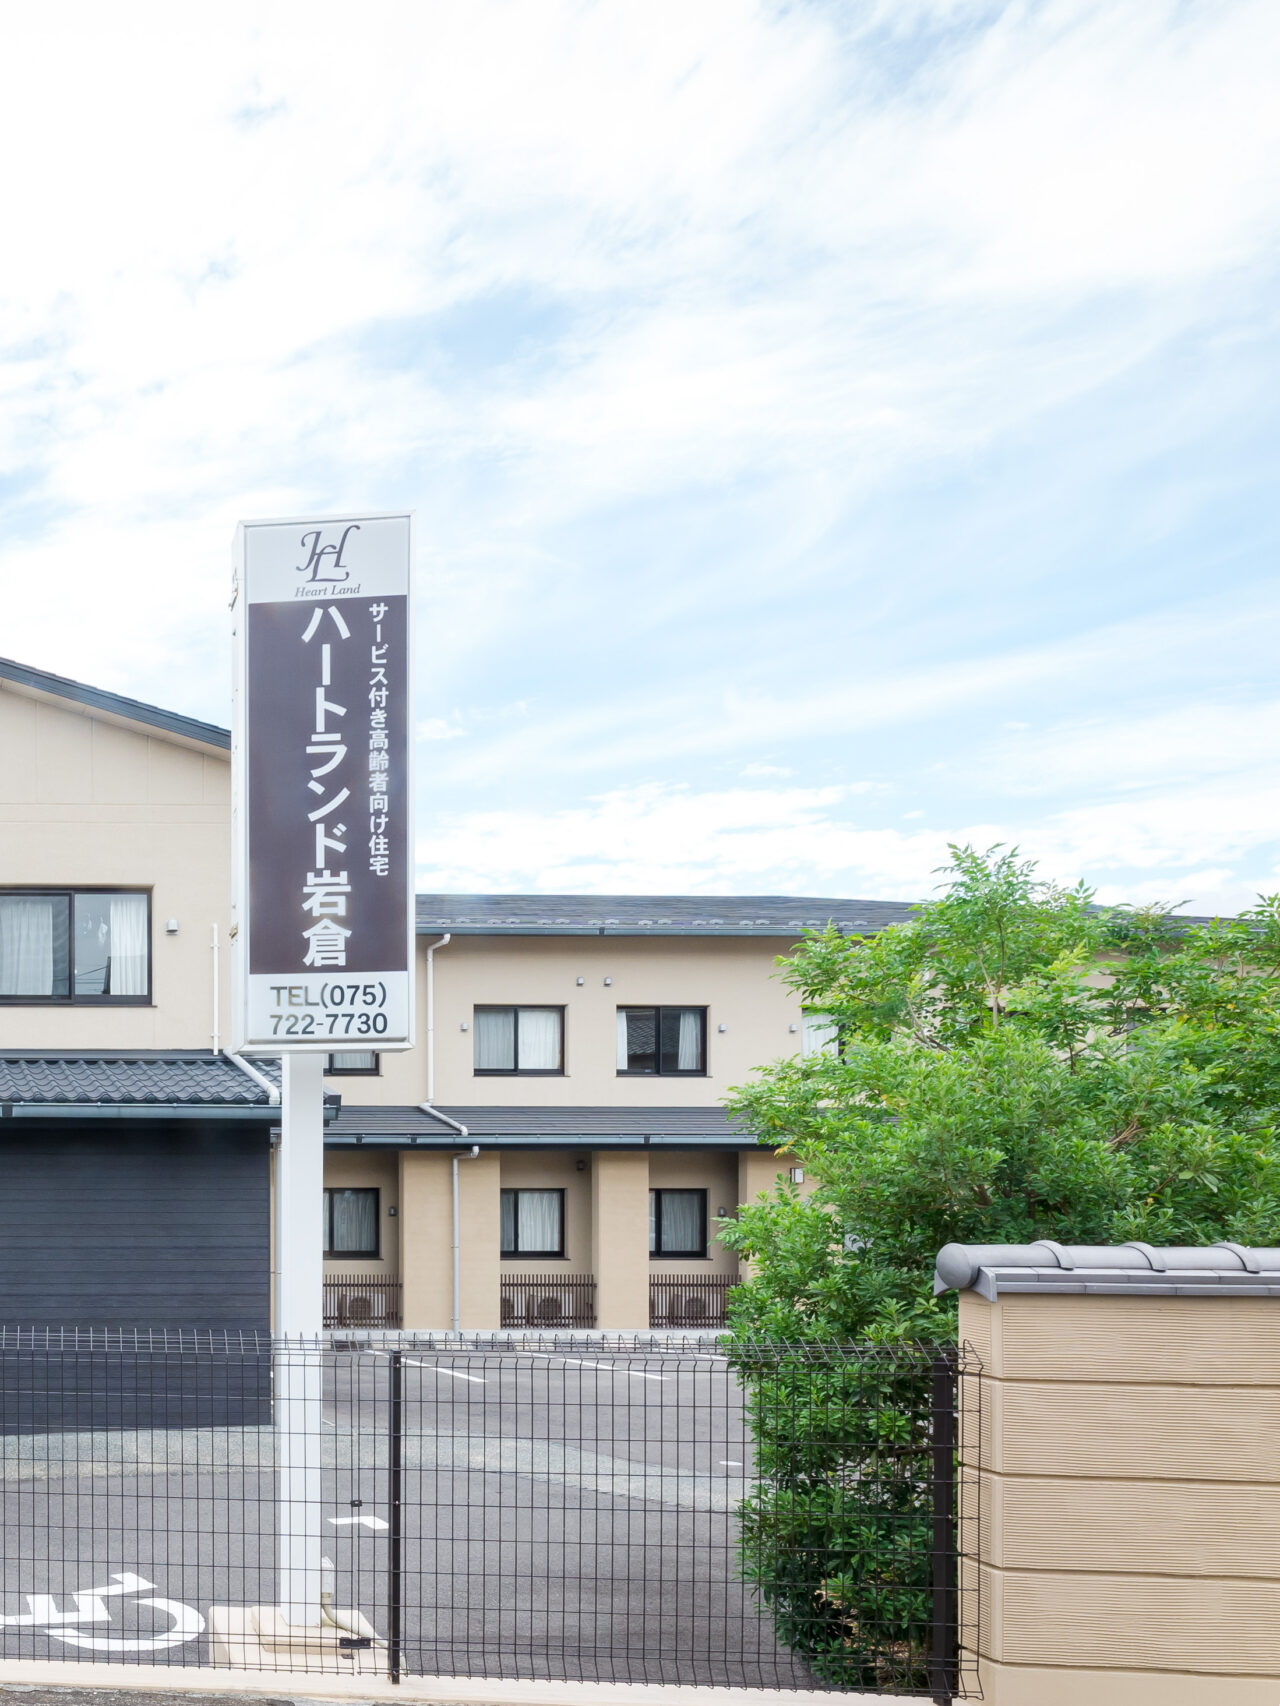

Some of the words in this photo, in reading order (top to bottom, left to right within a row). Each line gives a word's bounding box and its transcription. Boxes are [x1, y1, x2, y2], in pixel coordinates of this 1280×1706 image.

[294, 585, 327, 597] Heart
[331, 584, 360, 595] Land
[368, 602, 389, 876] サービス付き高齢者向け住宅
[301, 605, 352, 967] ハートランド岩倉
[270, 981, 387, 1009] TEL(075)
[270, 1012, 388, 1035] 722-7730
